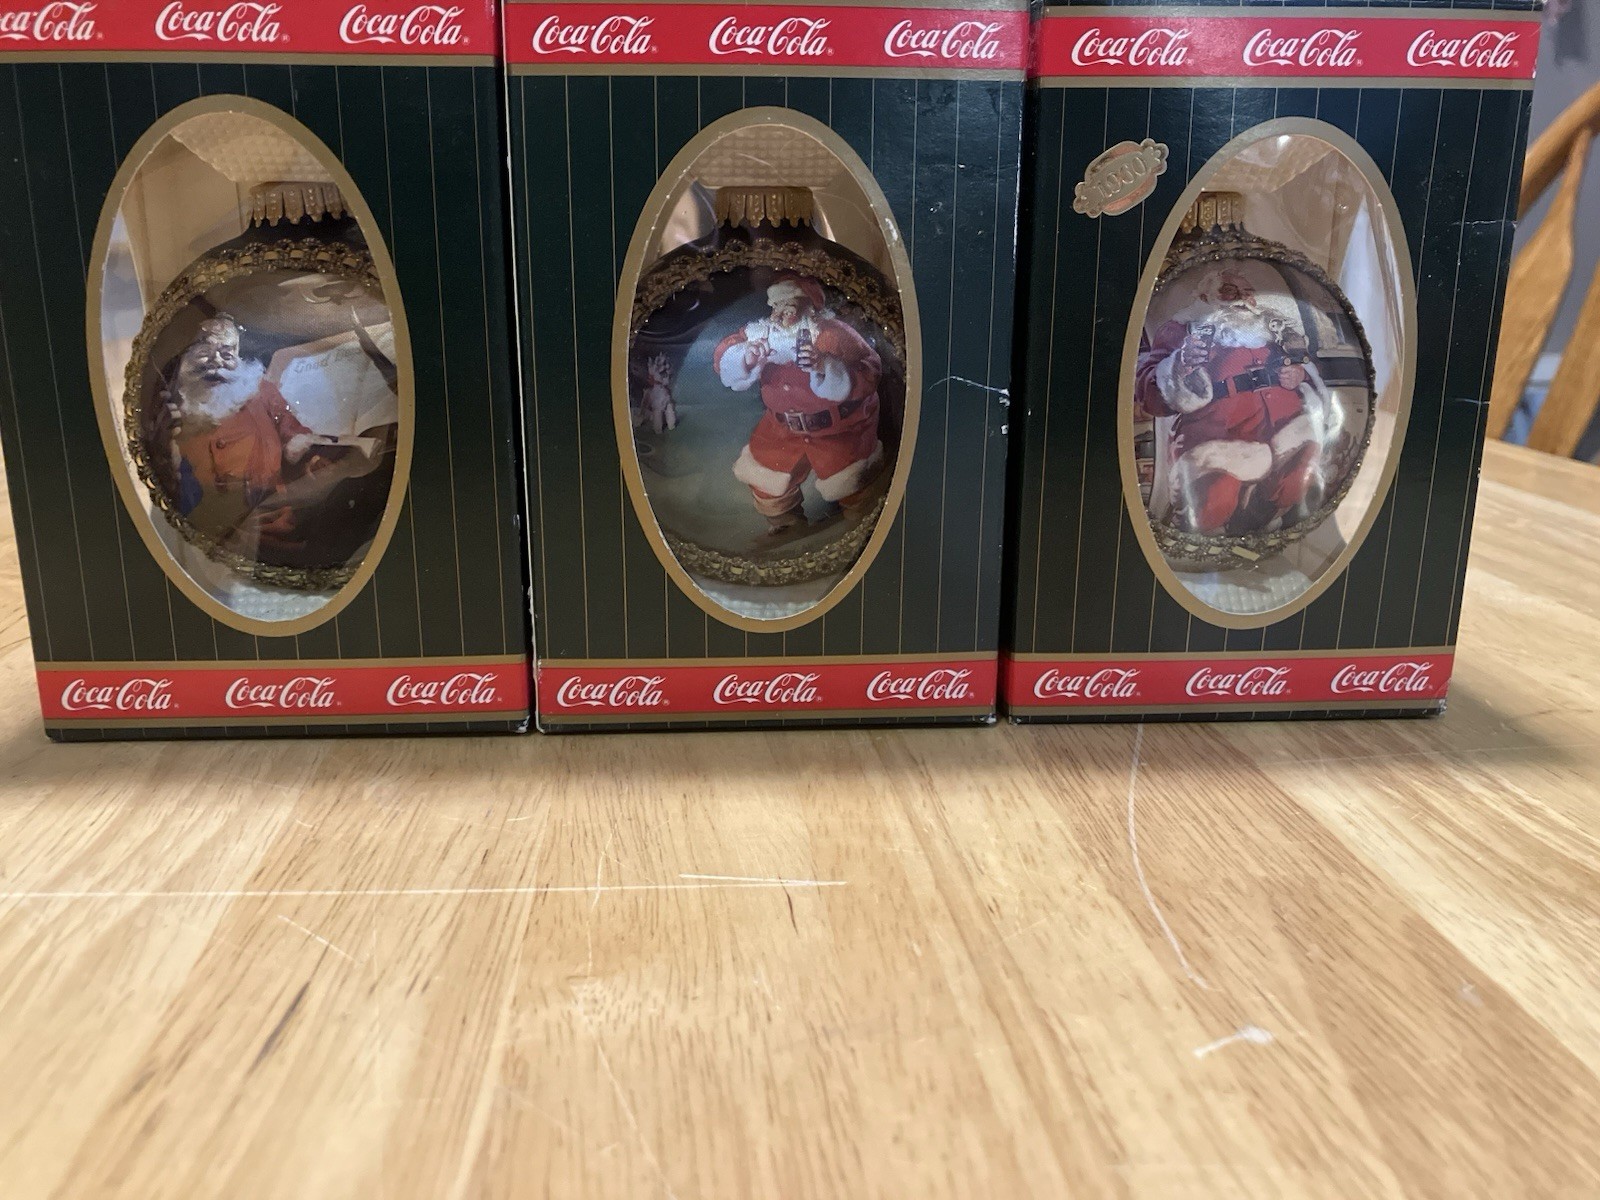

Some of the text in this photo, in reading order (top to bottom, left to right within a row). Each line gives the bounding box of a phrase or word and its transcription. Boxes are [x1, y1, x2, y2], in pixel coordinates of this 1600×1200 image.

[0, 1, 465, 45] ca-Cola Coca-Cola Coca-Cola
[532, 15, 1003, 59] Coca-Cola Coca-Cola Coca-Cola
[1071, 27, 1520, 68] Coca-Cola Coca-Cola Coca-Cola
[61, 672, 498, 711] Coca-Cola Coca-Cola Coca-Cola
[556, 668, 973, 707] Coca-Cola Coca-Cola Coca-Cola
[1033, 662, 1433, 699] Coca-Cola Coca-Cola Coca-Cola
